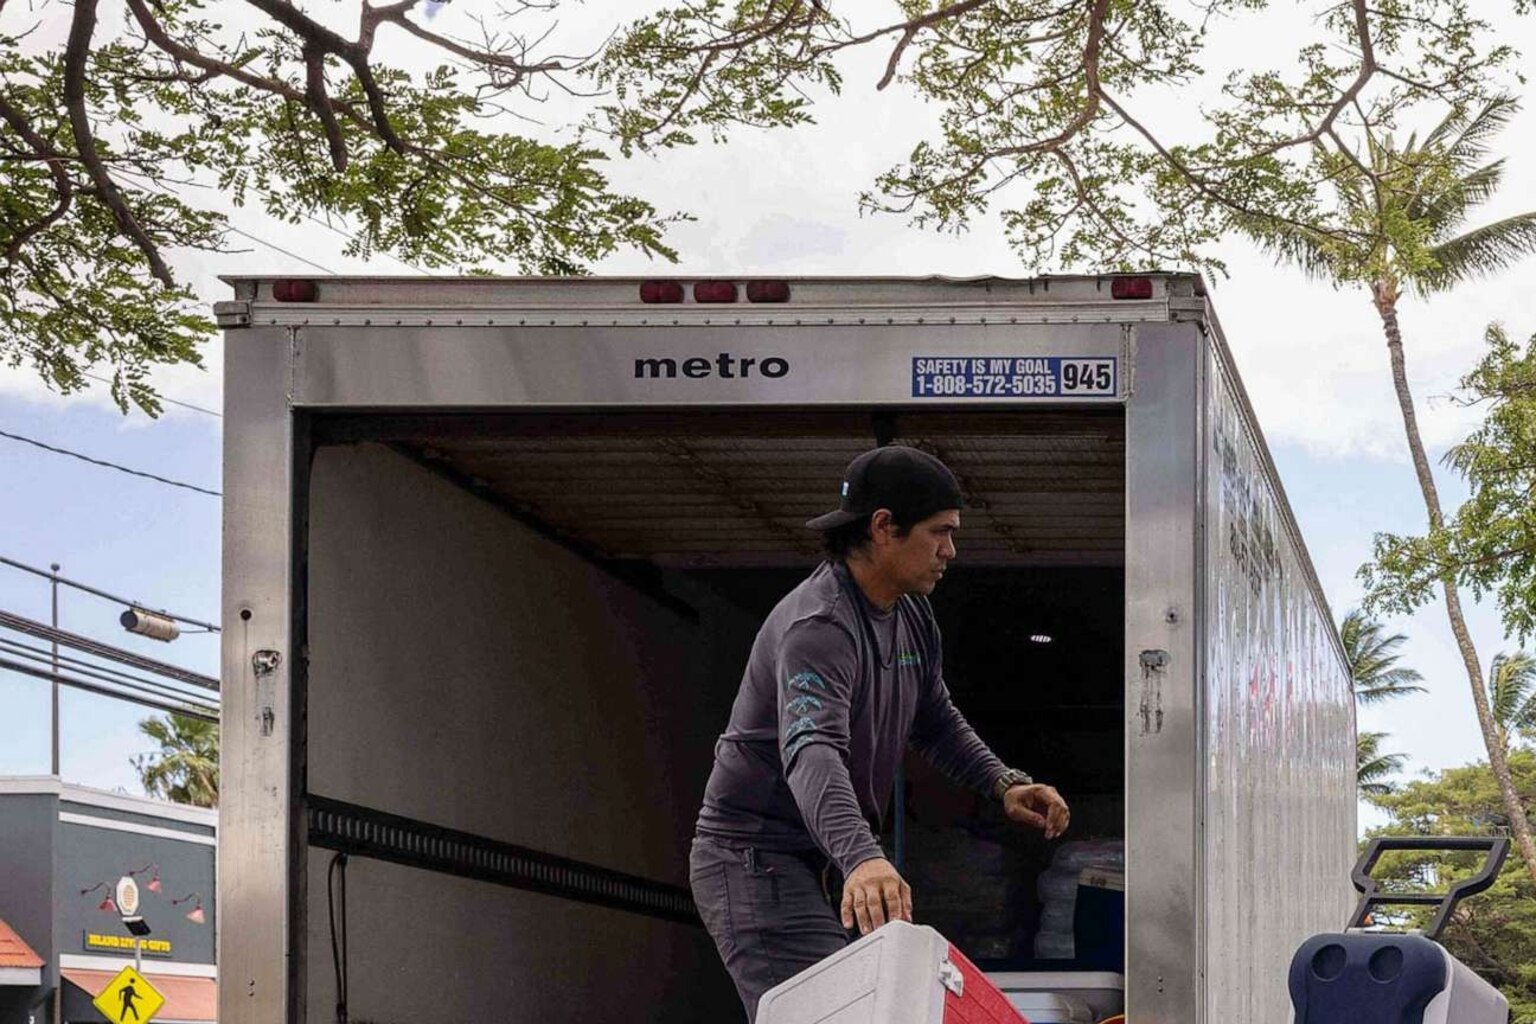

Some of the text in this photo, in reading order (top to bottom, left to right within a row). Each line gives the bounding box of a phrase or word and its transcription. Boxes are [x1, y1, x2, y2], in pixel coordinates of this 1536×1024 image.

[634, 353, 790, 379] metro
[916, 359, 1050, 374] SAFETY IS MY GOAL
[1063, 363, 1111, 390] 945
[916, 375, 1056, 395] 1-808-572-5035
